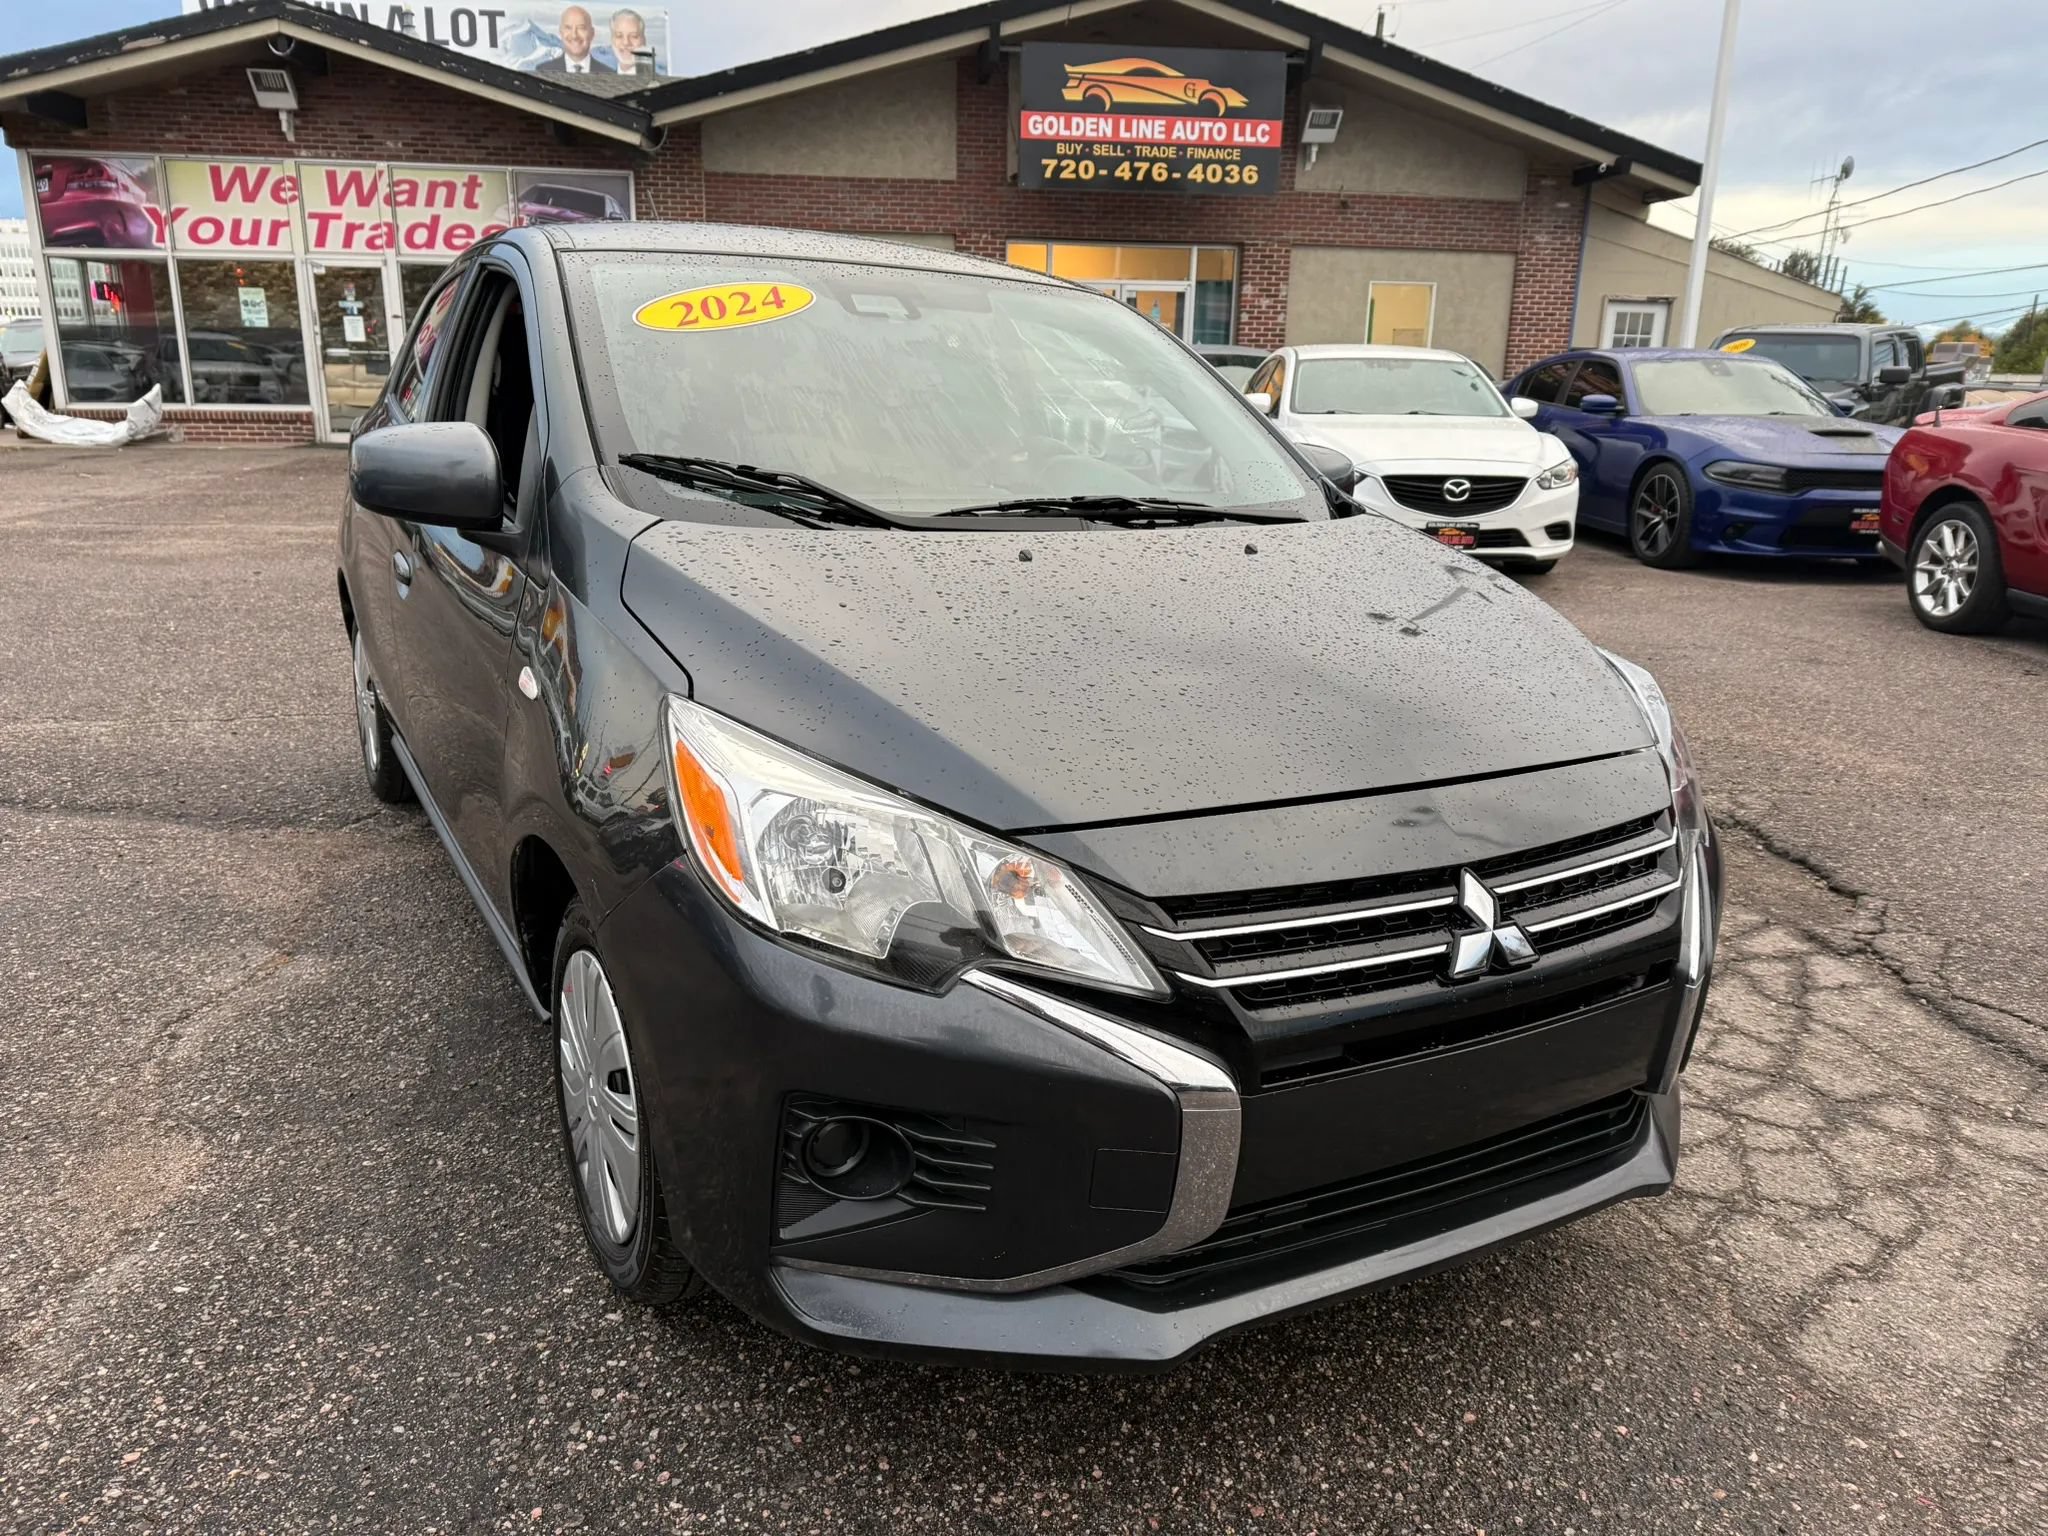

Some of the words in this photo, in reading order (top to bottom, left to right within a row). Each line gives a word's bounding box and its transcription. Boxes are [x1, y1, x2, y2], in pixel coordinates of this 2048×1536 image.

[424, 6, 506, 48] LOT
[1028, 115, 1113, 137] GOLDEN
[1119, 118, 1166, 139] LINE
[1171, 120, 1227, 142] AUTO
[1233, 122, 1270, 143] LLC
[1056, 143, 1083, 155] BUY
[1092, 144, 1125, 157] SELL
[1135, 146, 1177, 158] TRADE
[1186, 147, 1241, 160] FINANCE
[208, 164, 299, 204] We
[325, 169, 484, 210] Want
[142, 206, 290, 247] Your
[670, 286, 786, 327] 2024
